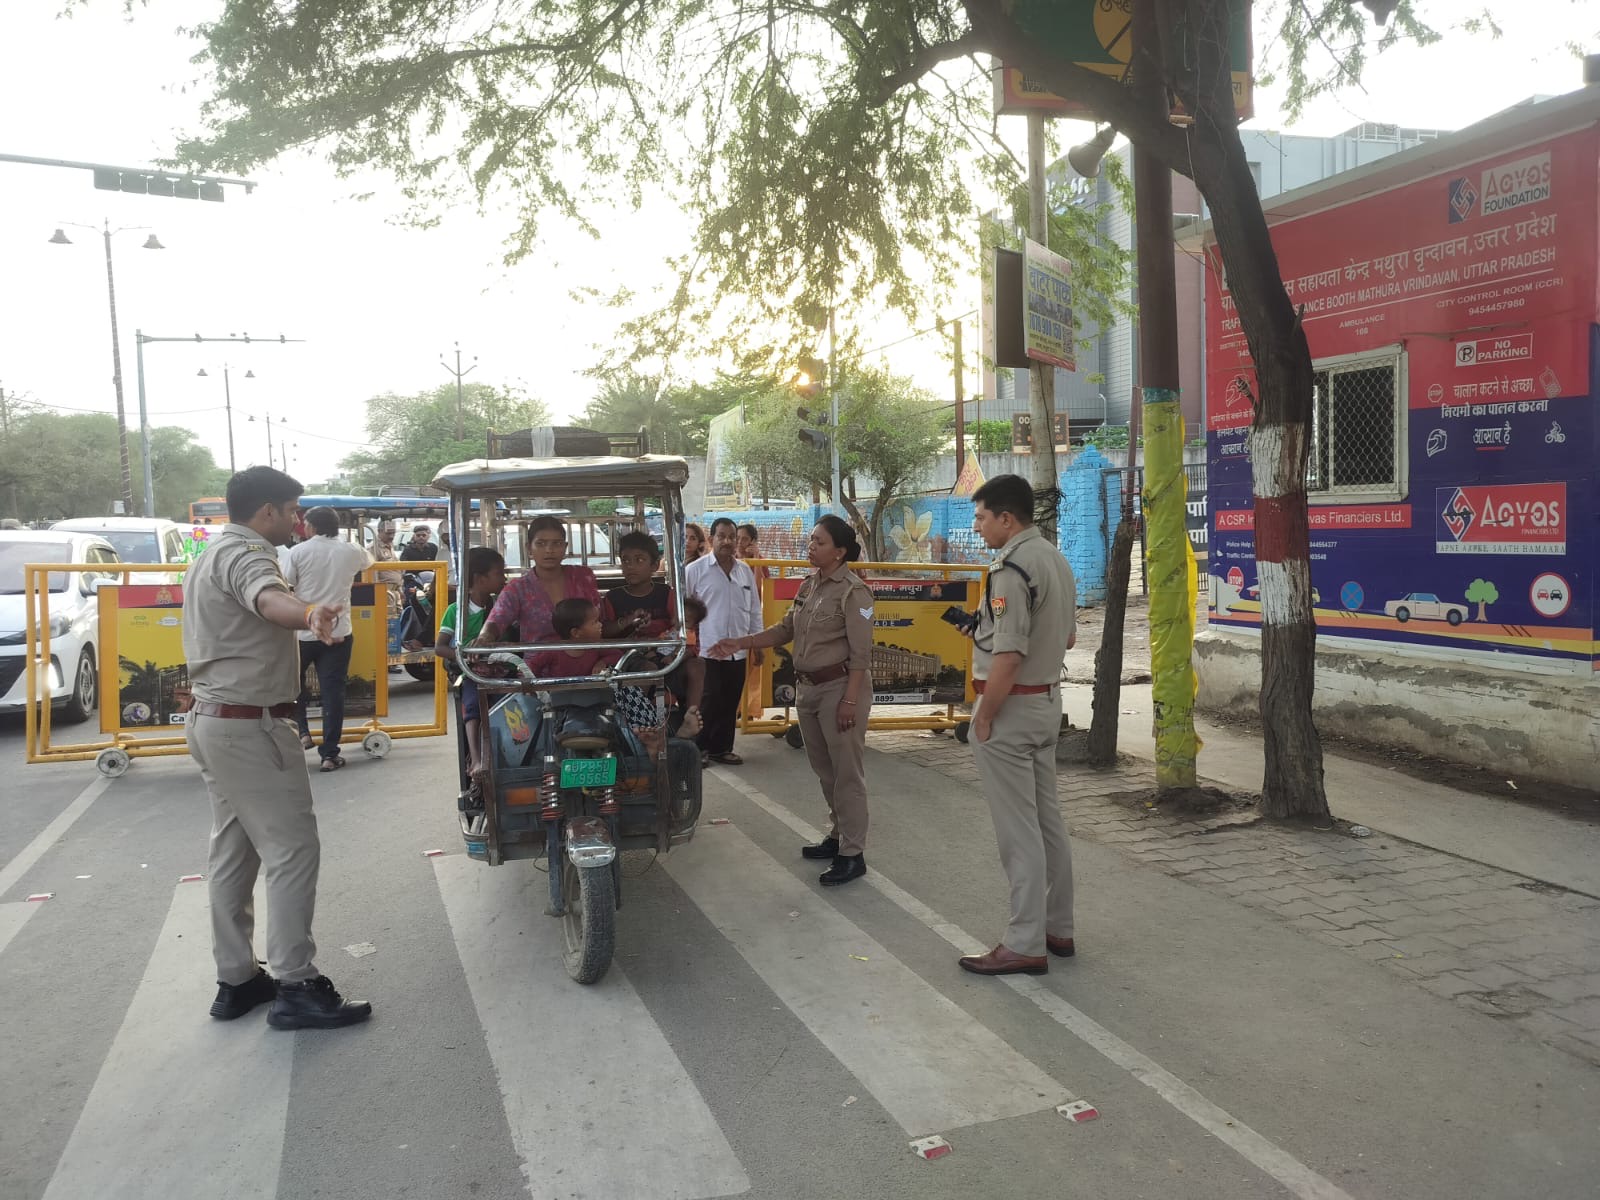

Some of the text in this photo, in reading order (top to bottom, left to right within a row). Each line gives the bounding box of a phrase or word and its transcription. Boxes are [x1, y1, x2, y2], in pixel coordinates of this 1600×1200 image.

[1484, 185, 1549, 213] FOUNDATION
[1298, 268, 1341, 294] सहायता
[1344, 258, 1370, 280] केन्द्र
[1373, 251, 1410, 278] मथुरा
[1514, 211, 1557, 242] प्रदेश
[1326, 291, 1356, 310] BOOTH
[1358, 282, 1400, 301] MATHURA
[1463, 260, 1498, 280] UTTAR
[1501, 247, 1556, 271] PRADESH
[1457, 290, 1501, 305] CONTROL
[1503, 283, 1533, 295] ROOM
[1535, 277, 1564, 290] (CCR)
[1339, 314, 1385, 329] AMBULANCE
[1494, 340, 1511, 349] NO
[1477, 346, 1528, 361] PARKING
[1453, 384, 1478, 398] चालान
[1479, 376, 1499, 395] कटने
[1501, 376, 1509, 394] से
[1472, 403, 1487, 417] का
[1488, 401, 1517, 415] पालन
[1517, 399, 1549, 413] करना
[1473, 420, 1512, 444] आसान है
[1226, 514, 1245, 525] CSR
[1329, 511, 1382, 524] Financiers
[1384, 510, 1405, 523] Ltd.
[1493, 544, 1519, 552] SAATH
[1522, 544, 1565, 553] HAMAARA
[1229, 576, 1243, 585] STOP
[898, 584, 923, 595] मथुरा
